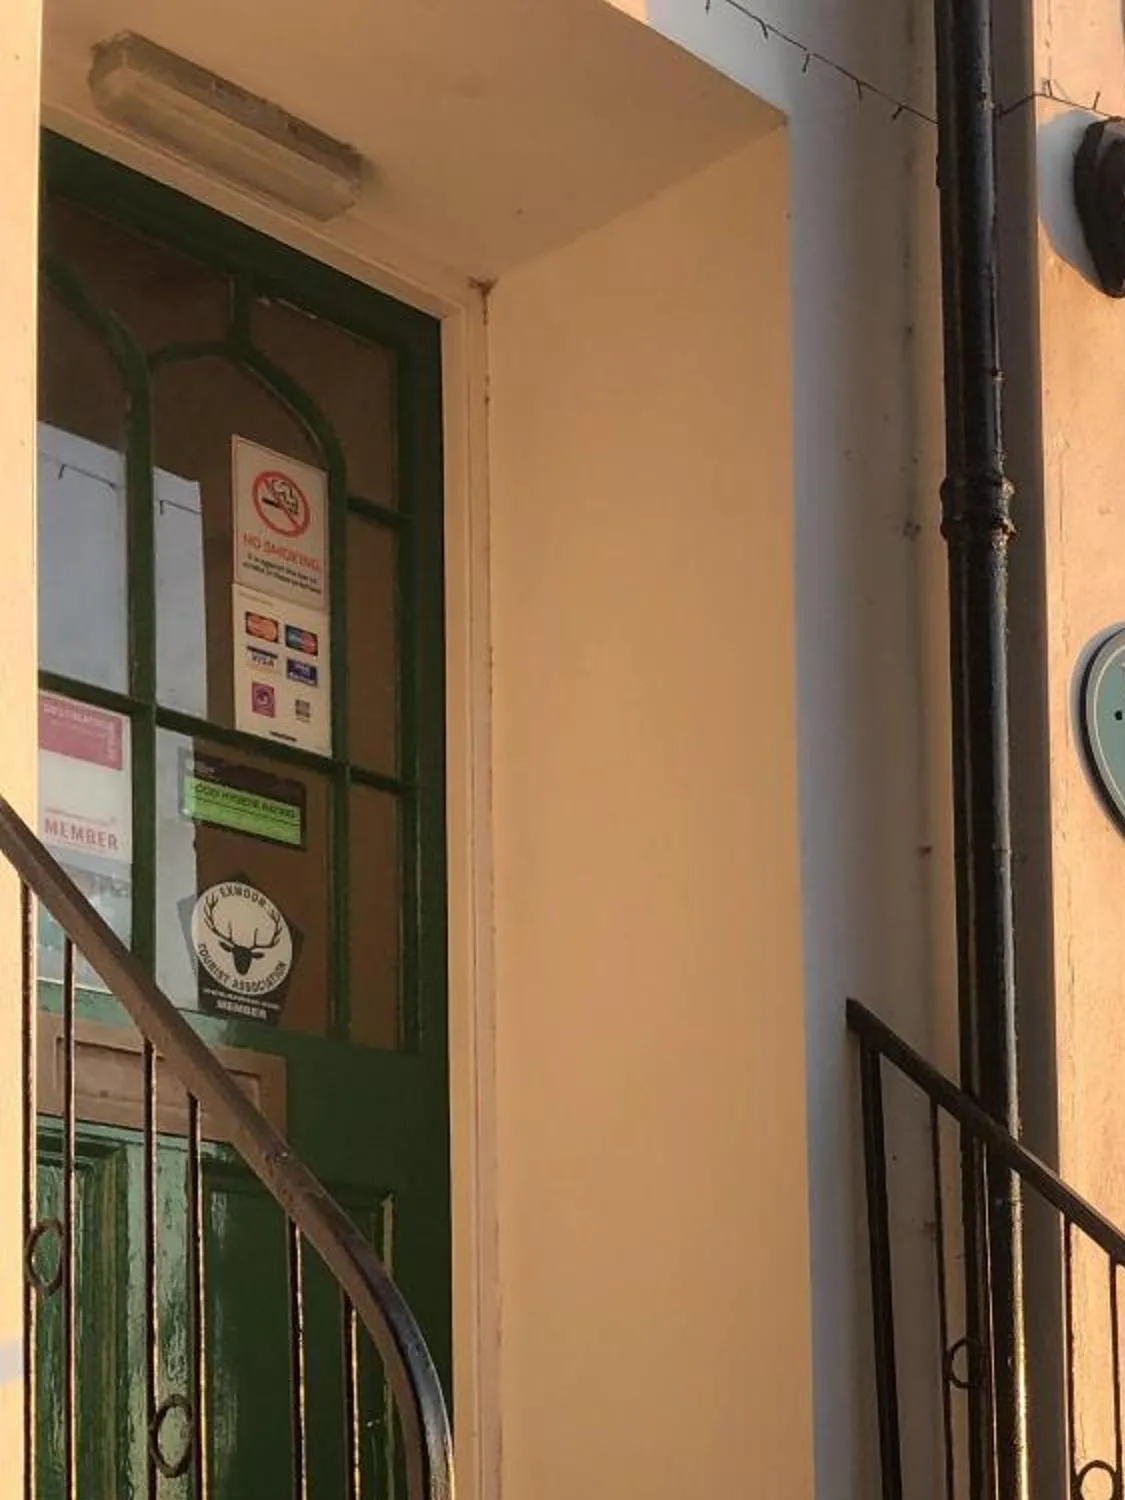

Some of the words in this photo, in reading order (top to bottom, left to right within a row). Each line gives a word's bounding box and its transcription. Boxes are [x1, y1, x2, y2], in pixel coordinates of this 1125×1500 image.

[243, 531, 262, 550] NO
[262, 541, 322, 571] SMOKING
[44, 818, 119, 850] MEMBER
[219, 883, 268, 908] EXMOOR
[197, 942, 231, 983] TOURIST
[231, 960, 288, 993] ASSOCIATION
[215, 999, 268, 1020] MEMBER
